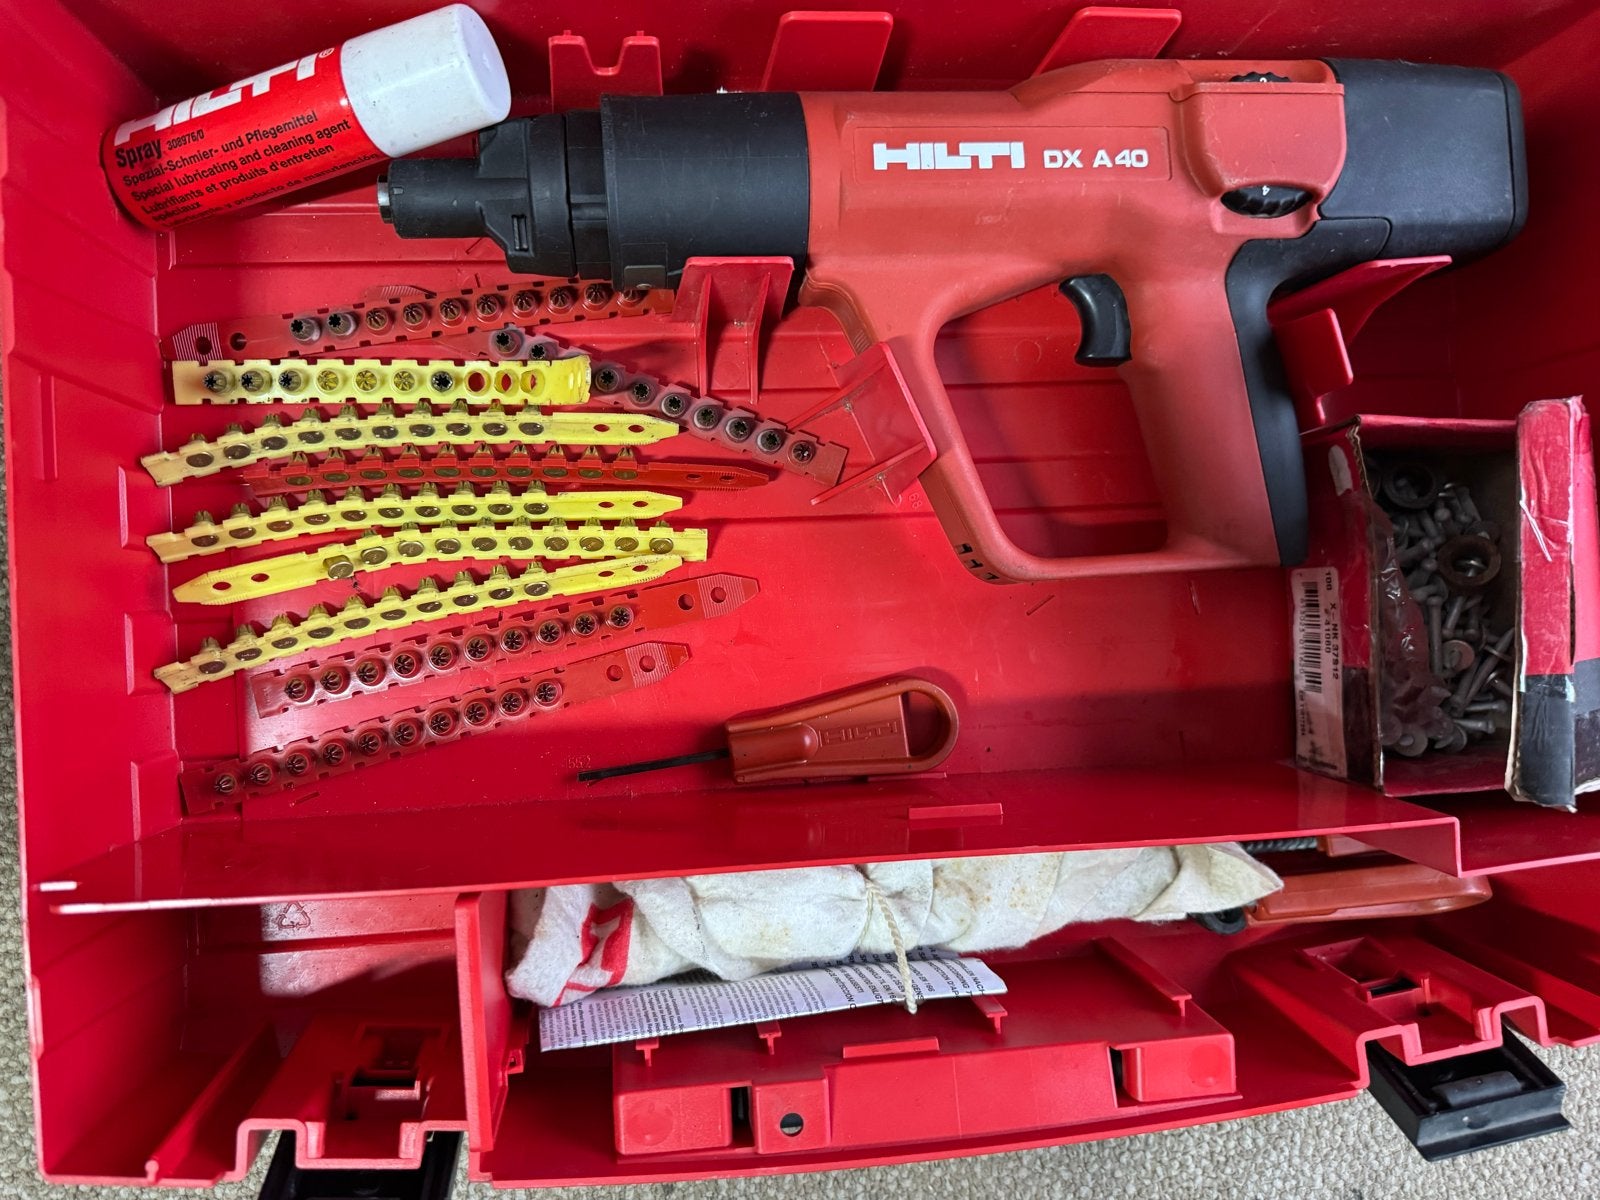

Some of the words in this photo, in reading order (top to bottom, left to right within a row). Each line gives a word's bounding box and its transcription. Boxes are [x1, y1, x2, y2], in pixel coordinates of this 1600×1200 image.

[115, 139, 162, 169] Spray
[123, 147, 219, 187] Spezial-Schmier-
[221, 135, 244, 154] und
[245, 110, 318, 145] Pflegemittel
[131, 179, 175, 202] Special
[174, 161, 239, 188] lubricating
[240, 148, 262, 166] and
[264, 132, 316, 158] cleaning
[316, 119, 352, 141] agent
[873, 141, 1025, 171] HILTI
[1043, 149, 1083, 169] DX
[1092, 149, 1149, 169] A40
[141, 187, 205, 215] Lubrifiants
[205, 182, 217, 195] et
[220, 167, 269, 191] produits
[269, 144, 335, 172] d'entretien
[1325, 571, 1333, 591] 100
[818, 720, 898, 748] HILTI
